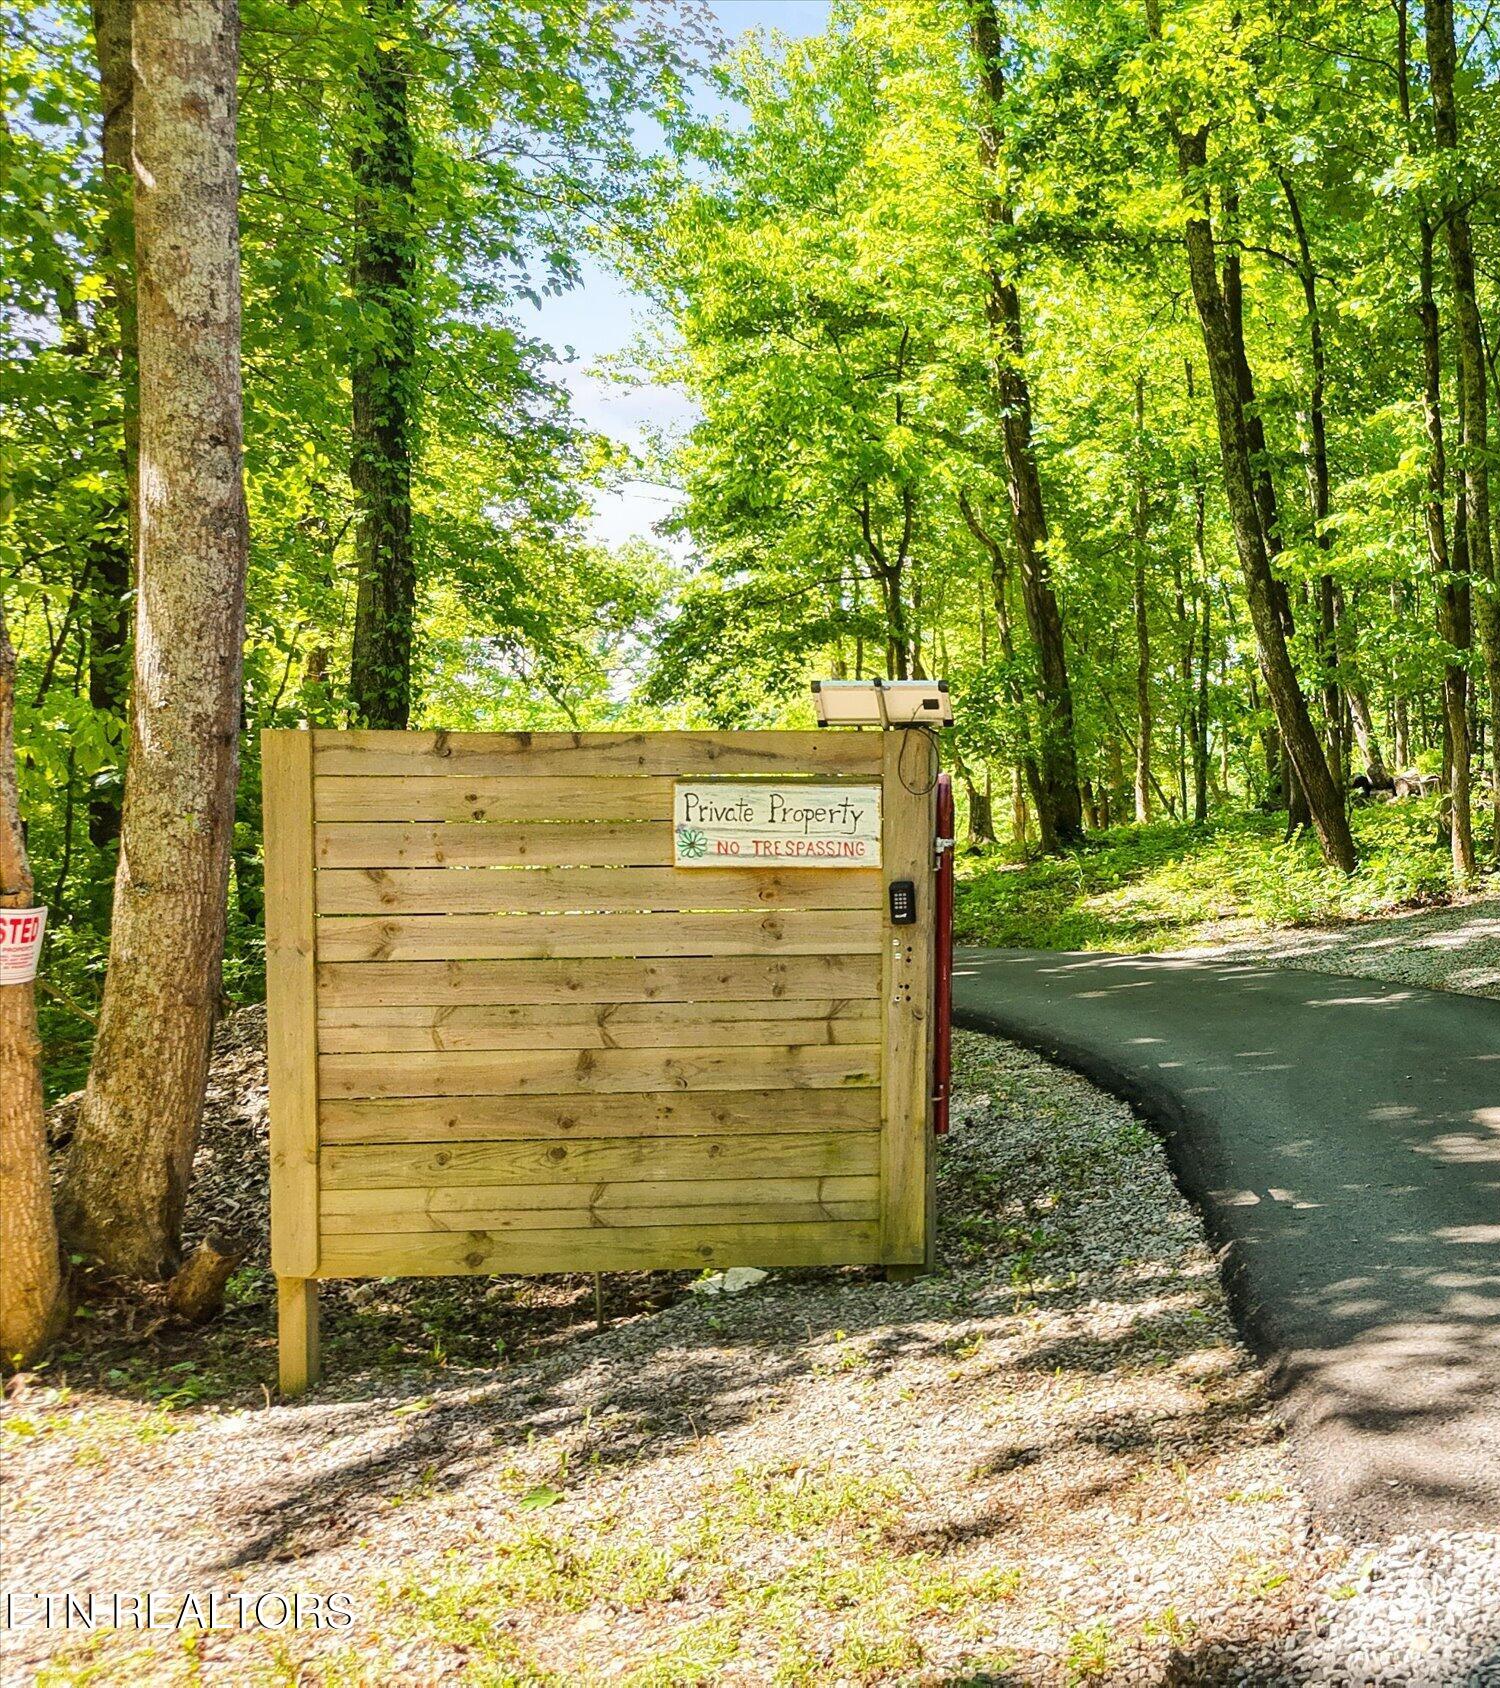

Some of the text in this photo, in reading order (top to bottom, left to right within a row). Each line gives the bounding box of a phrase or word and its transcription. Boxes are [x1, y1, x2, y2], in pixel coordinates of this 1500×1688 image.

[684, 792, 864, 835] Private Property
[717, 840, 866, 857] NO TRESPASSING
